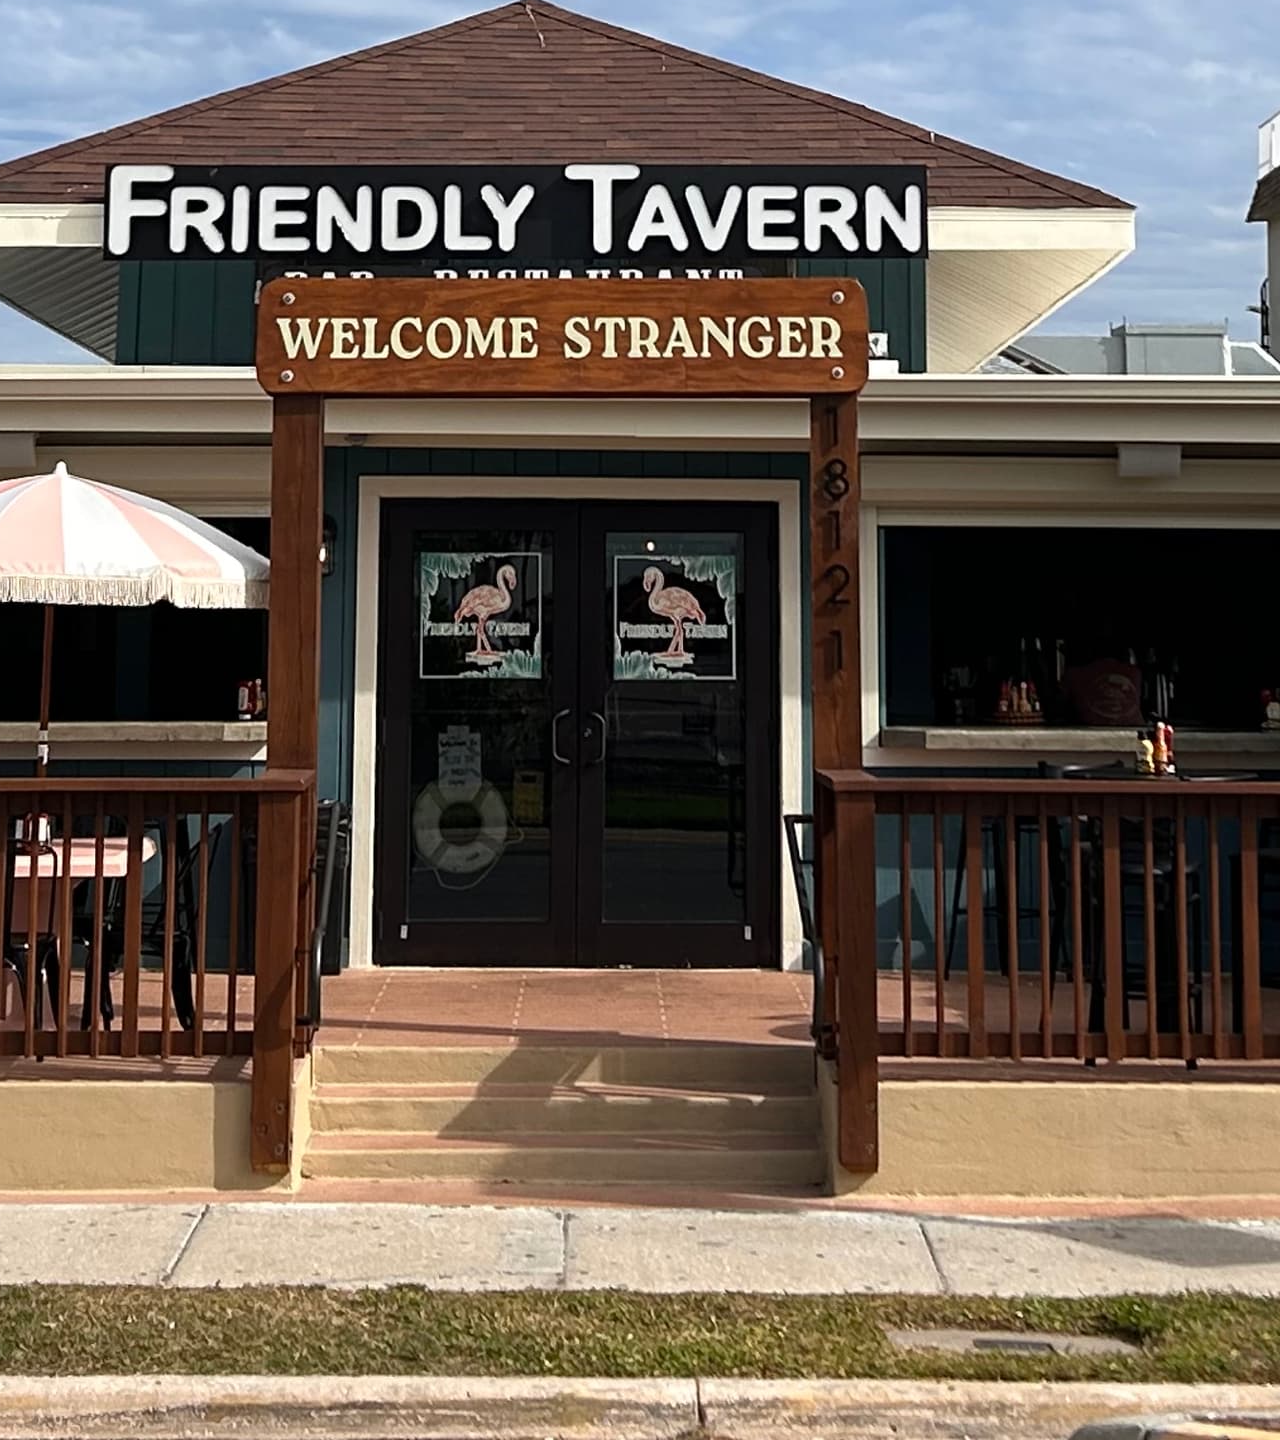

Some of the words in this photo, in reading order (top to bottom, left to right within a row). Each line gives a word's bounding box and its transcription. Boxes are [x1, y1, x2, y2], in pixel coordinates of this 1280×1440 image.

[107, 164, 535, 255] FRIENDLY
[564, 164, 921, 254] TAVERN
[275, 316, 539, 360] WELCOME
[563, 316, 844, 360] STRANGER
[823, 406, 851, 673] 18121
